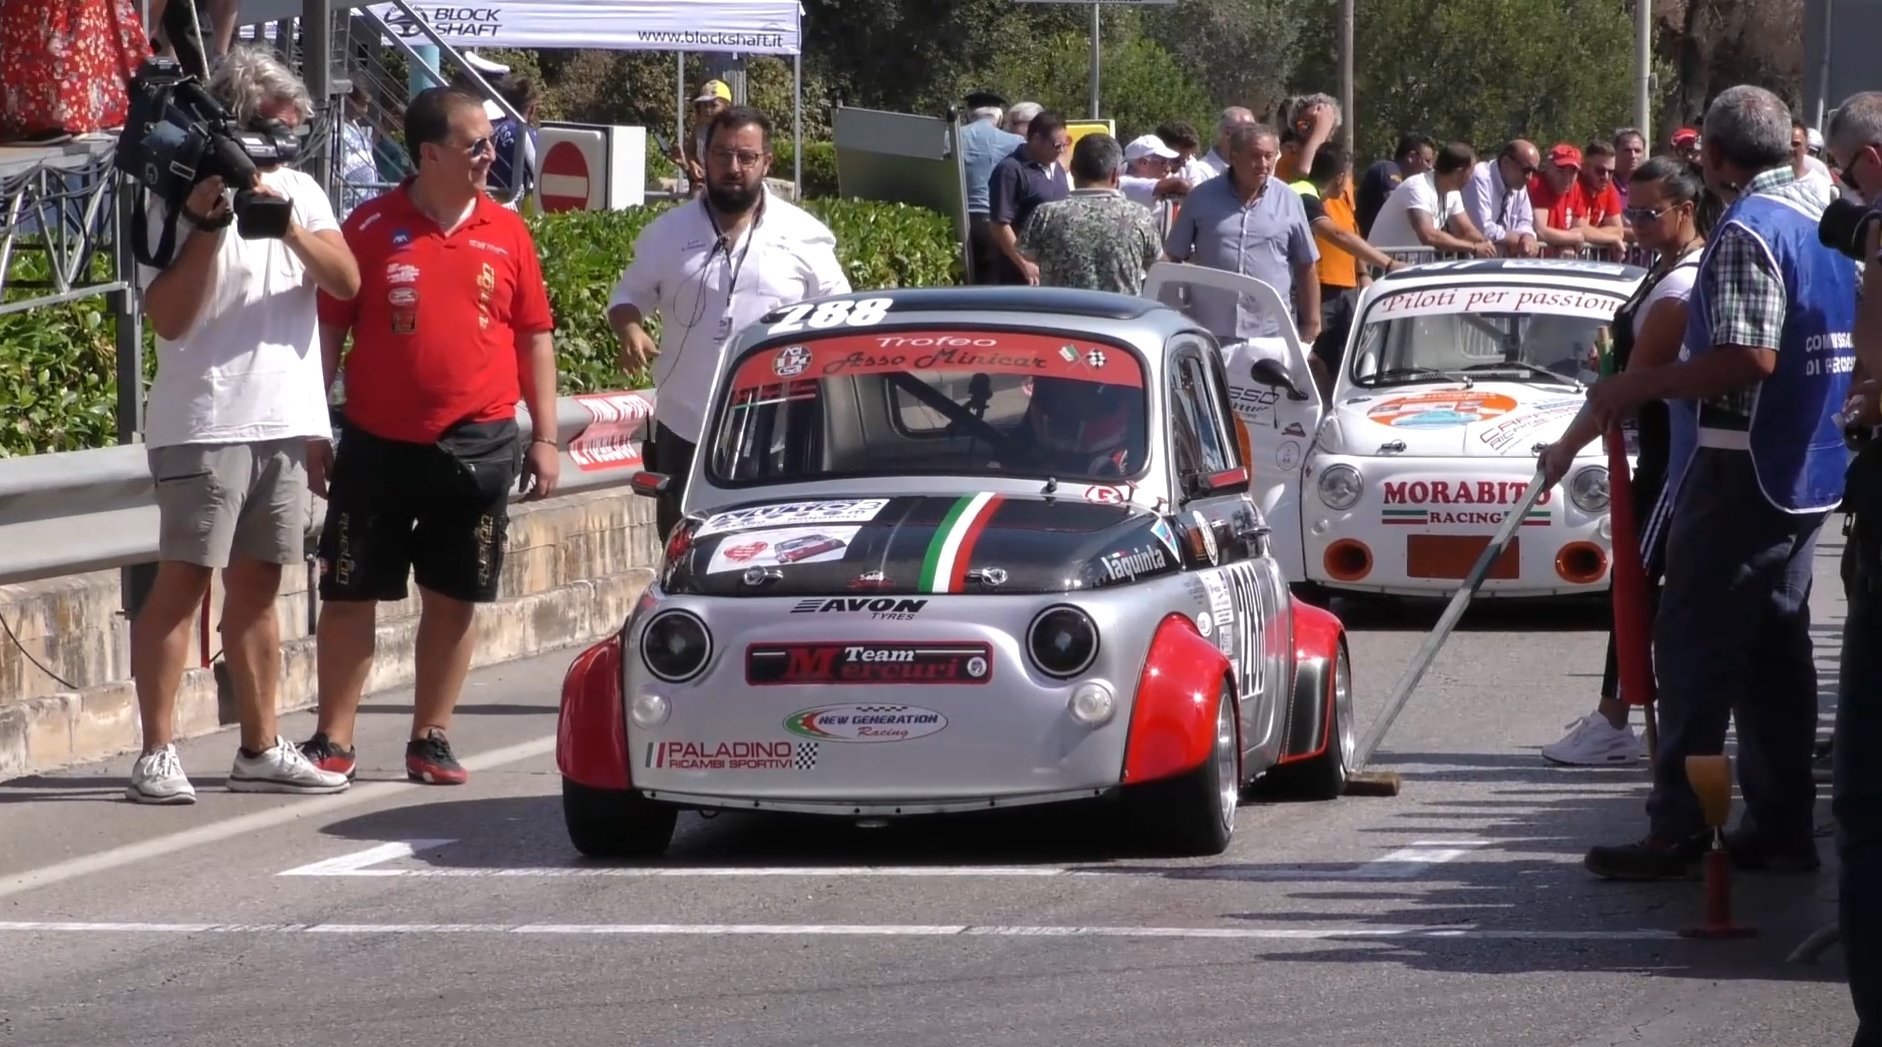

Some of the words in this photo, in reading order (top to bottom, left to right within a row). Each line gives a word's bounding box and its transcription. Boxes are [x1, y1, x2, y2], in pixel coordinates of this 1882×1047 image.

[434, 8, 501, 21] BLOCK
[435, 23, 502, 36] SHAFT
[638, 30, 783, 47] www.blockshaft.it
[1382, 288, 1459, 313] Piloti
[1465, 290, 1510, 312] per
[1512, 288, 1620, 311] passion
[767, 298, 894, 335] 288
[876, 336, 997, 348] Trofeo
[822, 351, 906, 375] Asso
[914, 348, 1047, 369] Minicar
[1806, 359, 1820, 376] DI
[1429, 511, 1503, 525] RACING
[819, 598, 928, 613] AVON
[871, 612, 916, 621] TYRES
[844, 646, 917, 662] Team
[782, 645, 959, 680] Mercuri
[818, 716, 849, 725] NEW
[852, 715, 938, 725] GENERATION
[857, 726, 910, 739] Racing
[668, 742, 792, 758] PALADINO
[669, 759, 726, 769] RICAMBI
[729, 759, 793, 769] SPORTIVI
